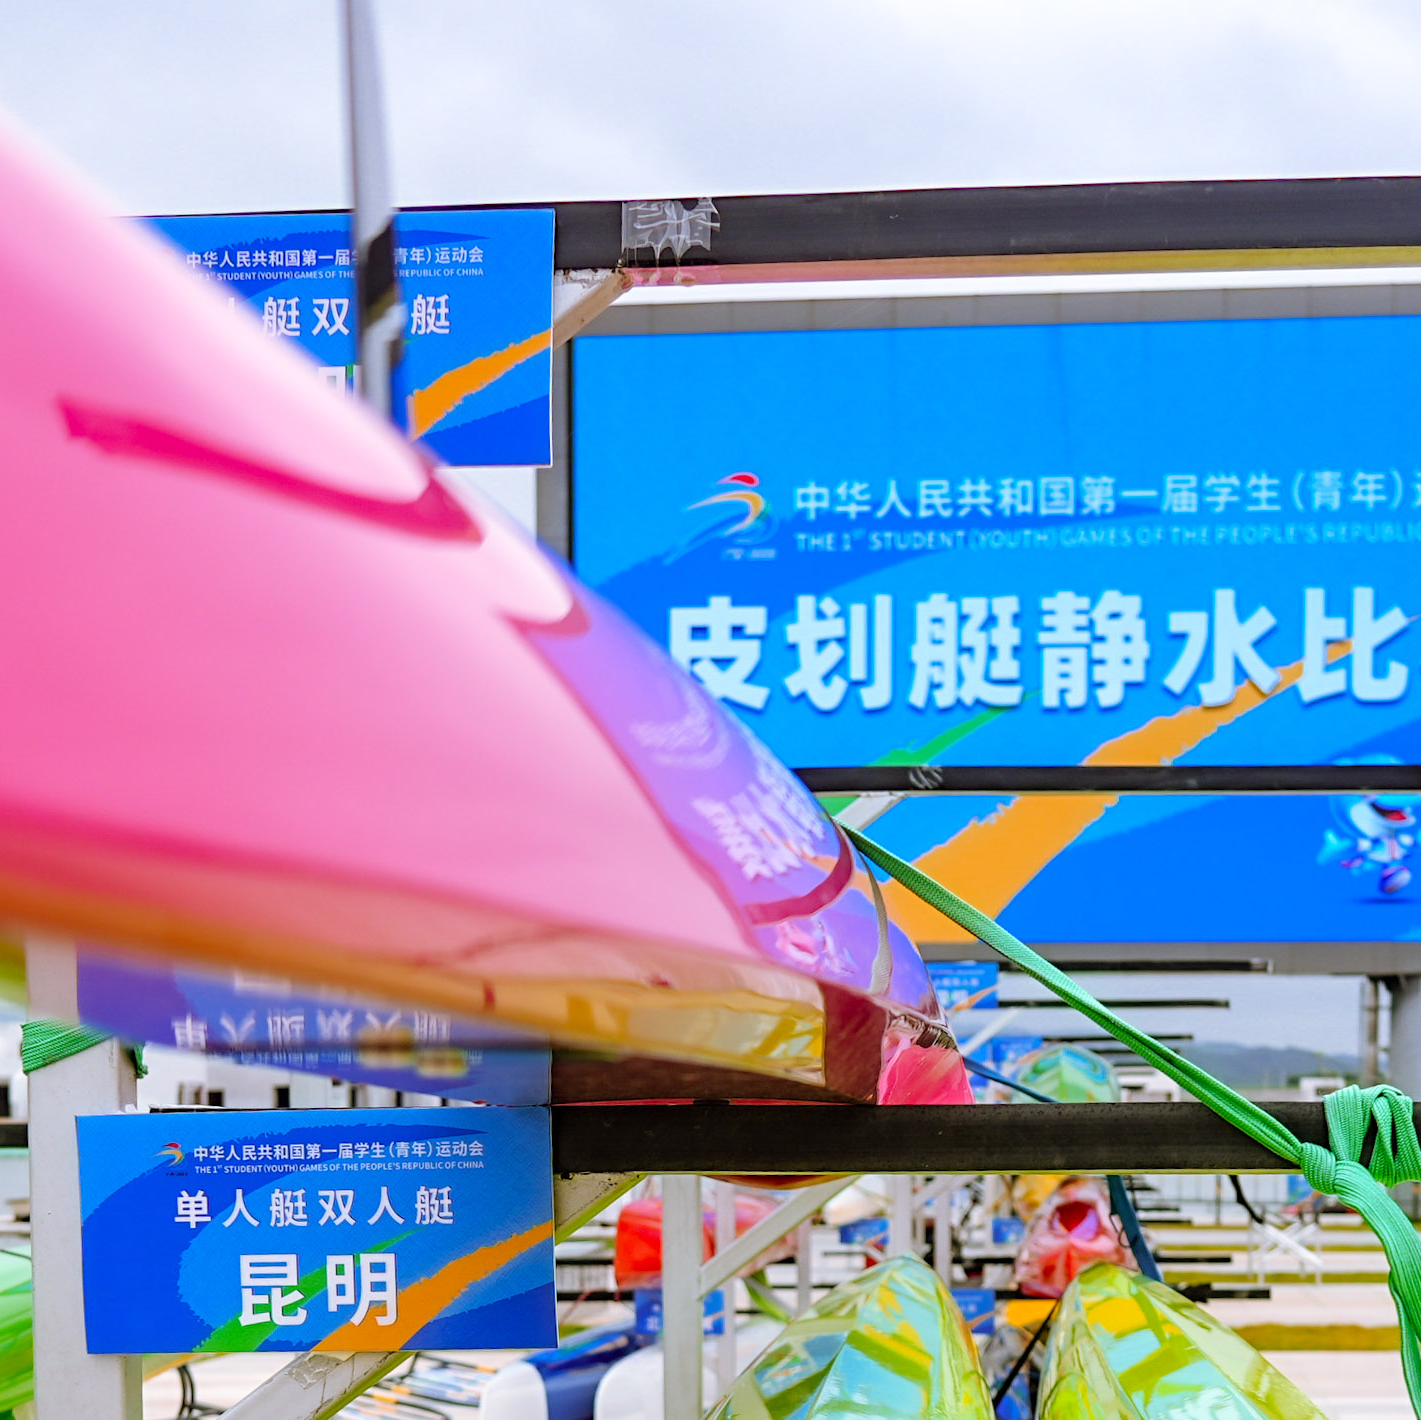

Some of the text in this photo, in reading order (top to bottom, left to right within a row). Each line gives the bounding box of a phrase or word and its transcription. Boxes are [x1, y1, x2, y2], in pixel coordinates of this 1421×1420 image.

[399, 268, 442, 278] REPUBLIC
[444, 268, 455, 277] OF
[456, 268, 484, 276] CHINA
[194, 1165, 212, 1174] THE
[224, 1164, 263, 1174] STUDENT
[264, 1164, 298, 1173] (YOUTH)
[300, 1164, 328, 1172] GAMES
[329, 1163, 340, 1172] OF
[342, 1162, 358, 1171] THE
[360, 1162, 400, 1171] PEOPLE'S
[402, 1161, 444, 1170] REPUBLIC
[444, 1161, 456, 1170] OF
[458, 1160, 484, 1169] CHINA
[174, 1185, 454, 1229] 单人艇双人艇
[238, 1252, 398, 1327] 昆明
